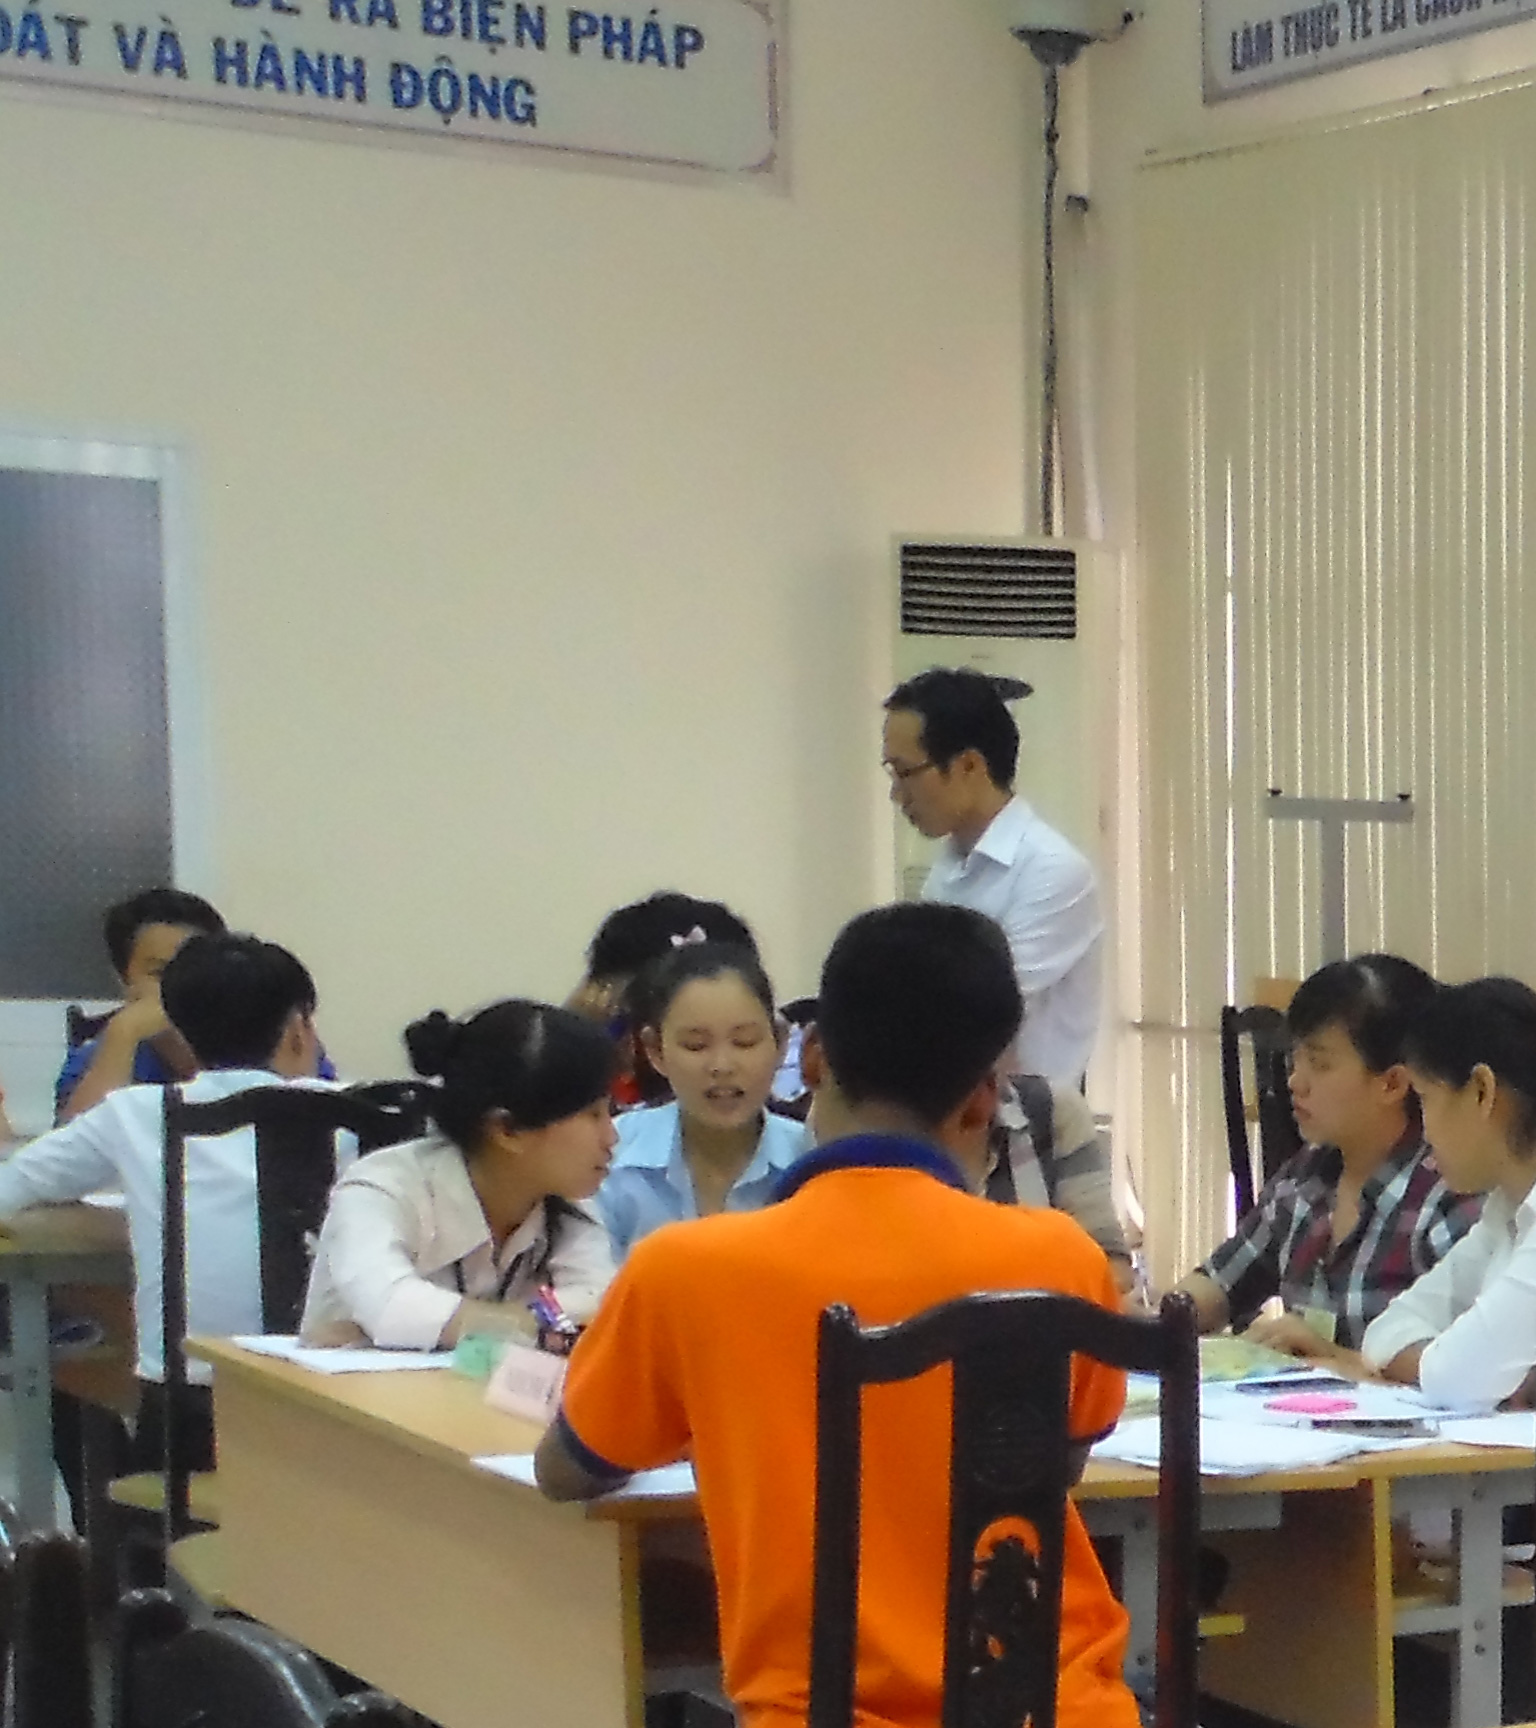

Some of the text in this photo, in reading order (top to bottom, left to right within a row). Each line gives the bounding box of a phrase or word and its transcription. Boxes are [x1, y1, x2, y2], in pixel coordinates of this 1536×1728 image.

[113, 14, 188, 79] VÀ
[213, 28, 366, 102] HÀNH
[390, 54, 537, 127] ĐỘNG
[568, 8, 706, 69] PHÁP
[1231, 20, 1273, 74] LÀM
[1281, 2, 1340, 59] THỰC
